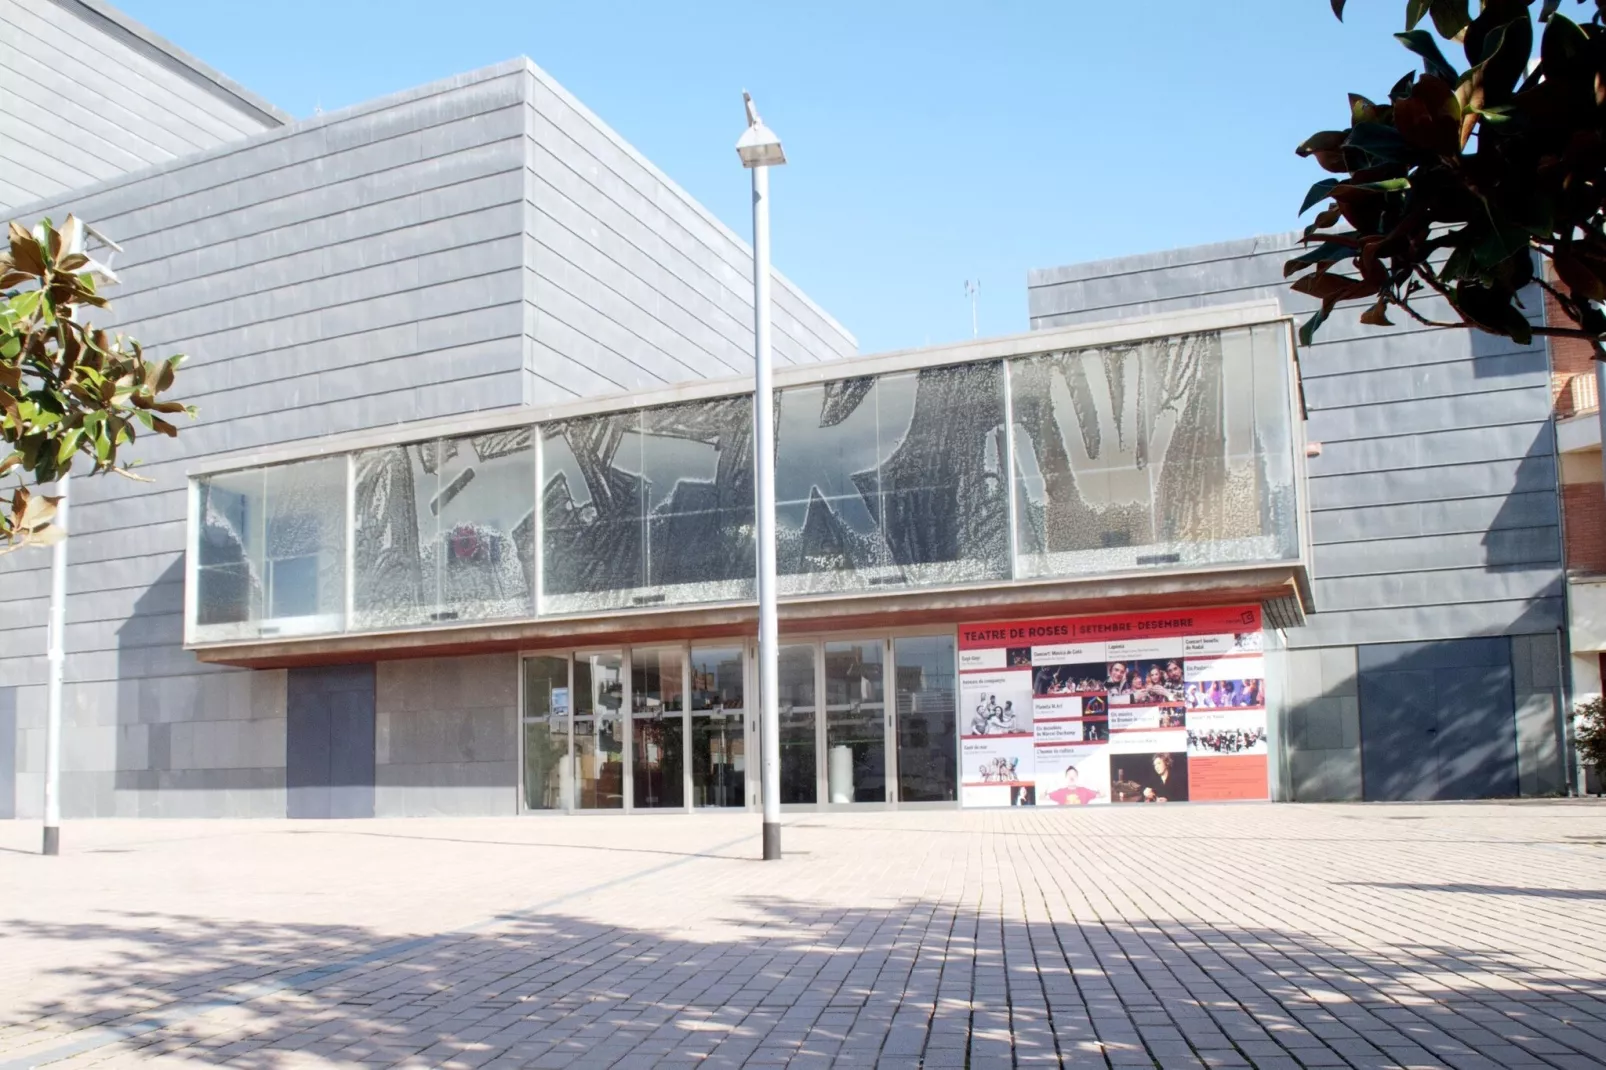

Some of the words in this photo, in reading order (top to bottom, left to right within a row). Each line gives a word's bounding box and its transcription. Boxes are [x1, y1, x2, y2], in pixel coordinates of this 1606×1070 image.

[963, 629, 1007, 641] TEATRE
[1009, 627, 1026, 639] DE
[1028, 625, 1069, 637] ROSES
